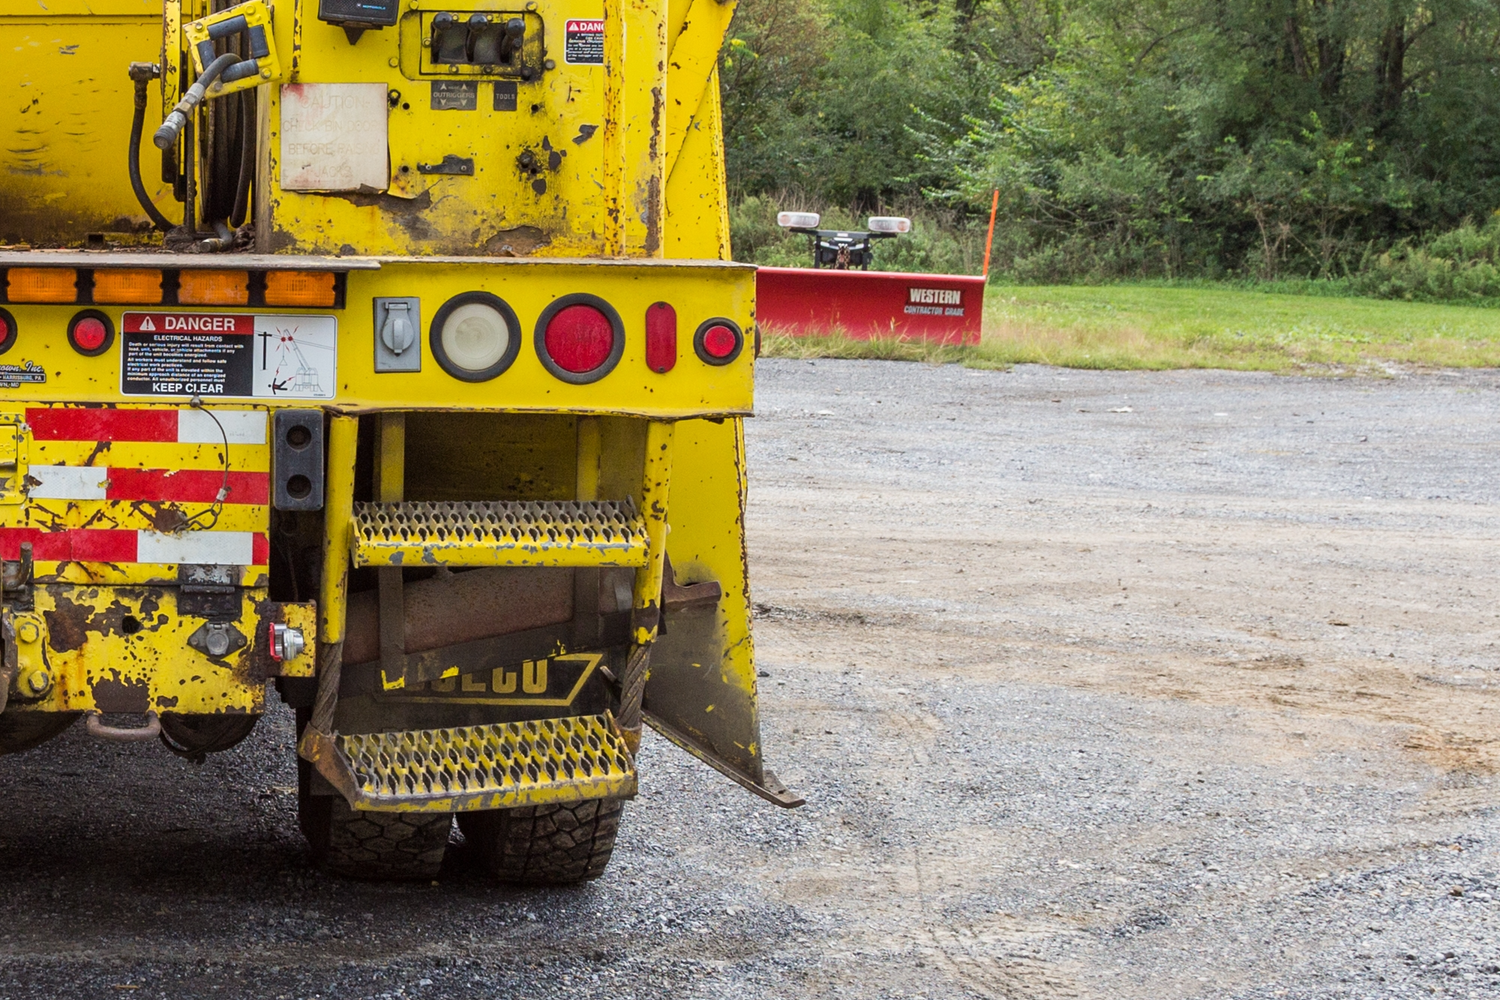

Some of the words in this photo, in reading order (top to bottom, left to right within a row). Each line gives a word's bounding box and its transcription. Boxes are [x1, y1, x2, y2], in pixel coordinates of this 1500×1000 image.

[433, 91, 475, 99] OUTRIGGERS
[288, 143, 334, 155] BEFORE
[910, 288, 961, 304] WESTERN
[904, 305, 943, 315] CONTRACTOR
[945, 307, 964, 316] GRADE
[165, 316, 235, 331] DANGER
[25, 361, 44, 372] Inc.
[152, 383, 183, 392] KEEP
[185, 383, 223, 393] CLEAR
